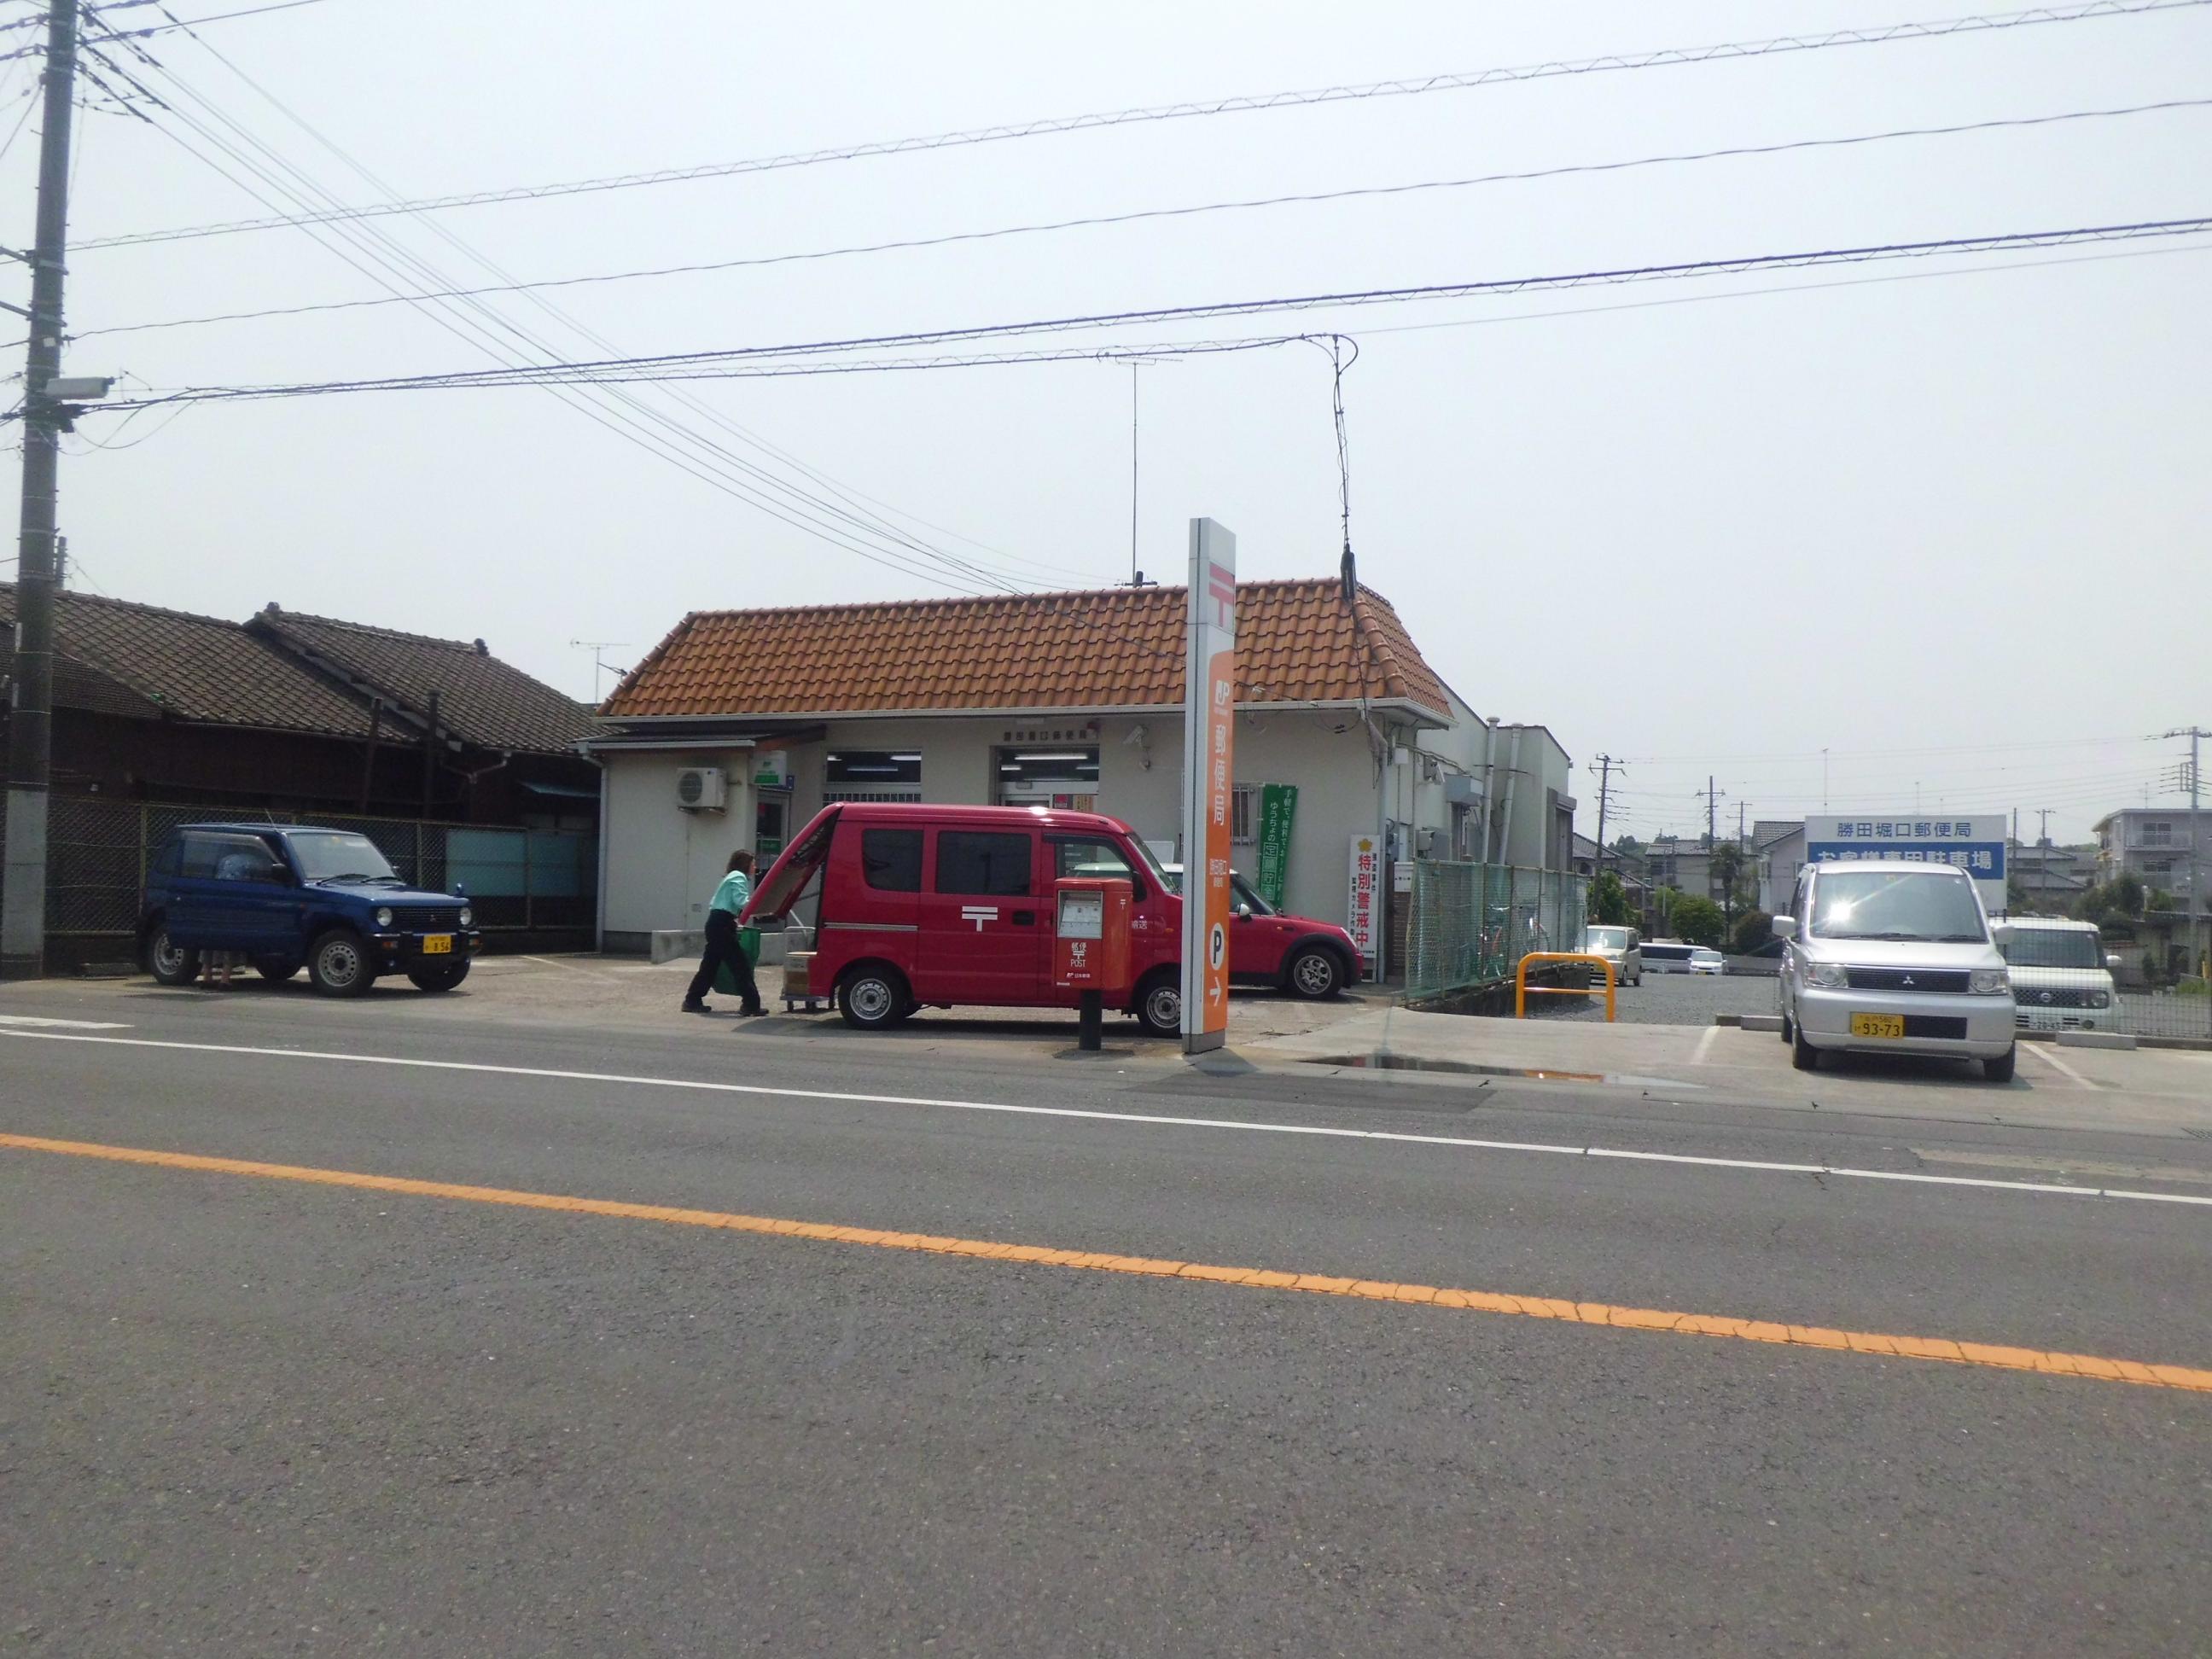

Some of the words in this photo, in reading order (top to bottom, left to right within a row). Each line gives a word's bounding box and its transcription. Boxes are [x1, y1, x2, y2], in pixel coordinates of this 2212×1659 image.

[1214, 724, 1226, 825] 郵便局
[1837, 822, 1971, 838] 勝田堀口郵便局
[1356, 853, 1372, 947] 特別警戒中
[1070, 958, 1086, 968] POST
[1863, 1022, 1901, 1037] 93-73
